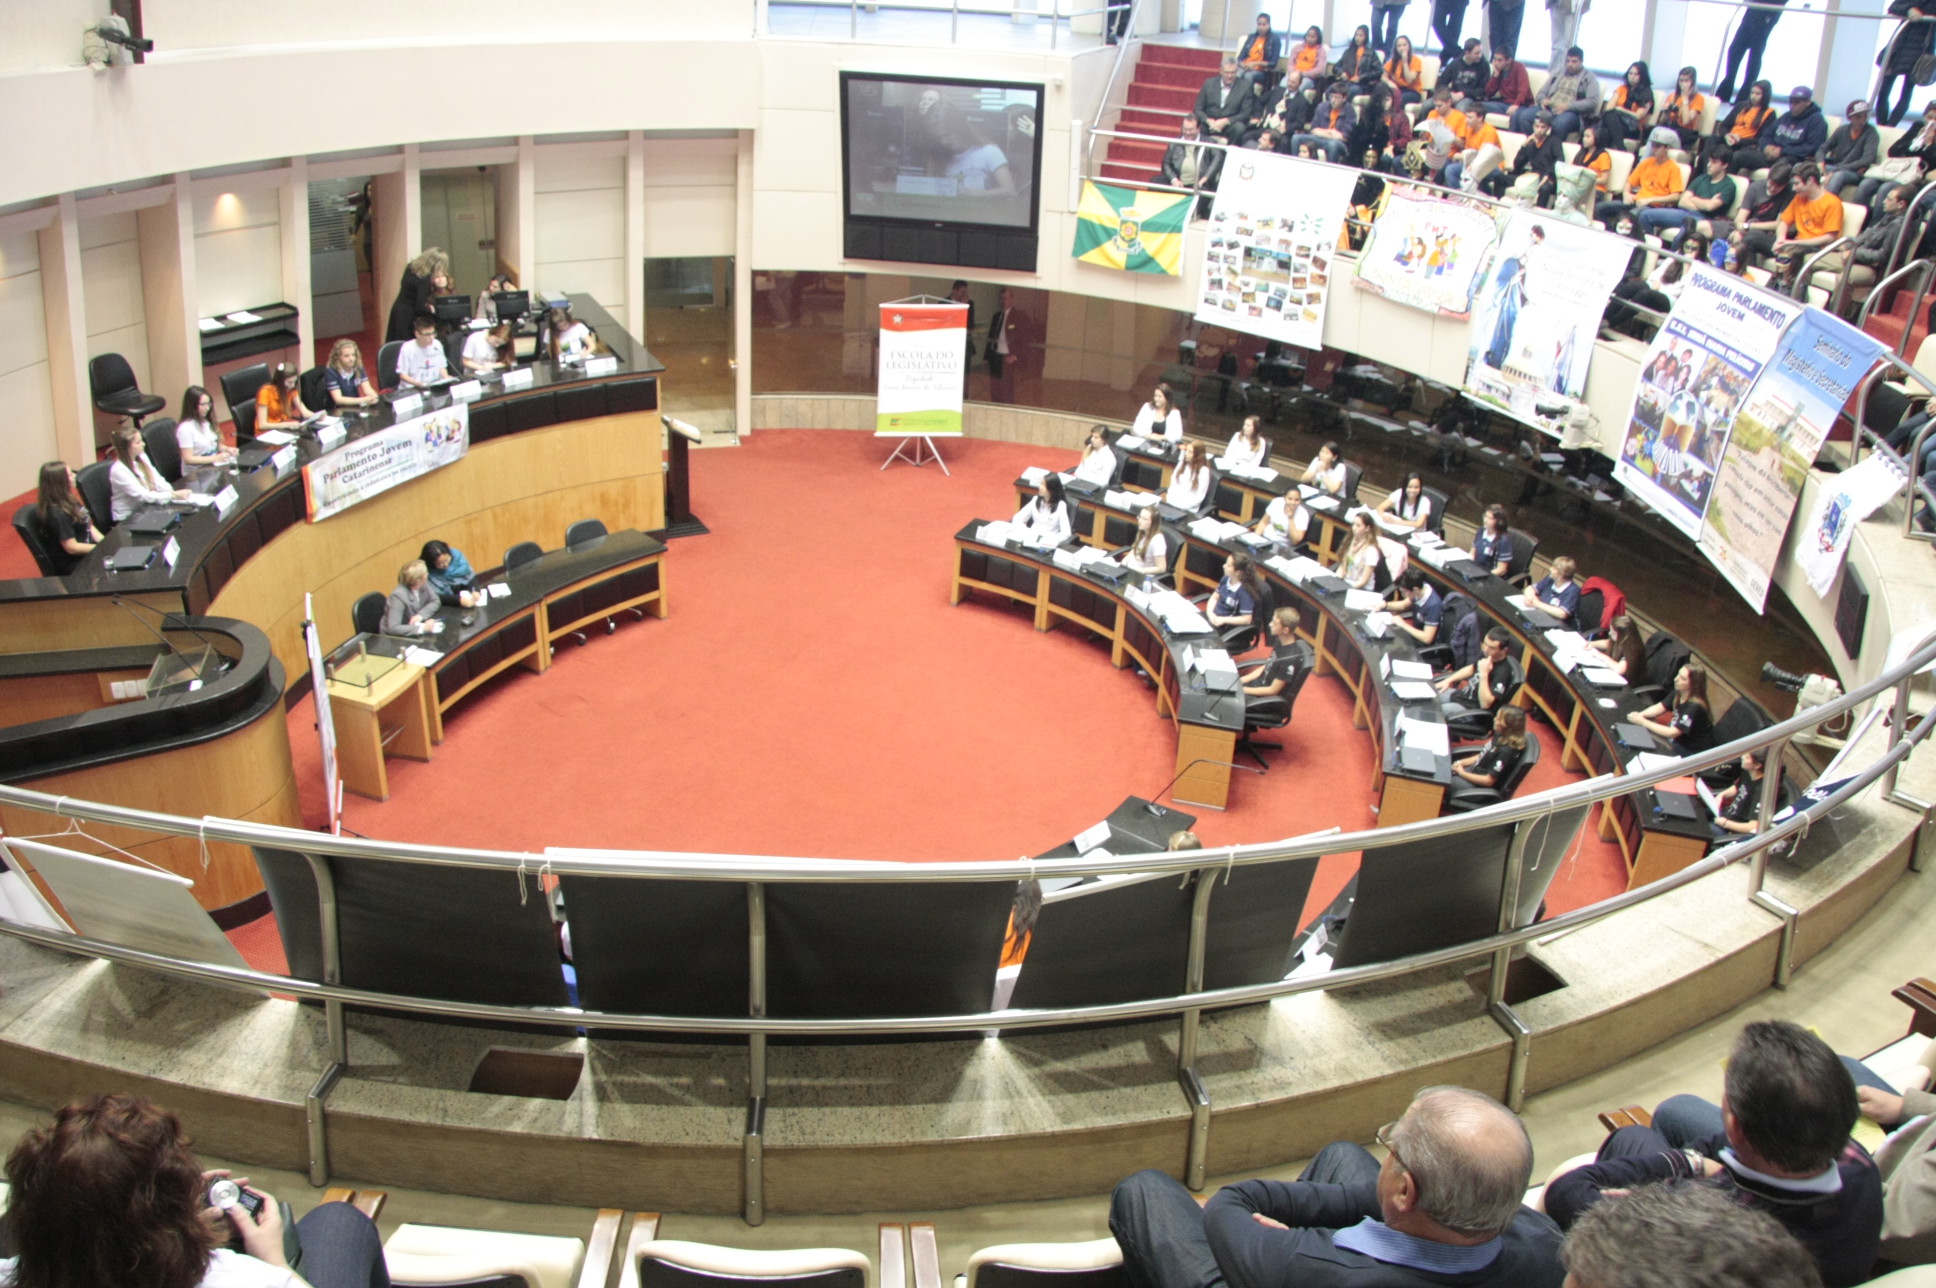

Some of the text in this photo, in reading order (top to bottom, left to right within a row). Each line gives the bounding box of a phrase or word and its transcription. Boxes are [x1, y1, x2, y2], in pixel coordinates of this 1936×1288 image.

[1691, 272, 1787, 330] PROGRAMA PARLAMENTO
[1716, 301, 1746, 323] JOVEM
[886, 360, 957, 370] LEGISLATIVO
[890, 350, 954, 360] ESCOLA DO
[323, 439, 413, 484] Parlamento Jovem
[344, 440, 384, 461] Programa
[342, 457, 393, 484] Catarinense
